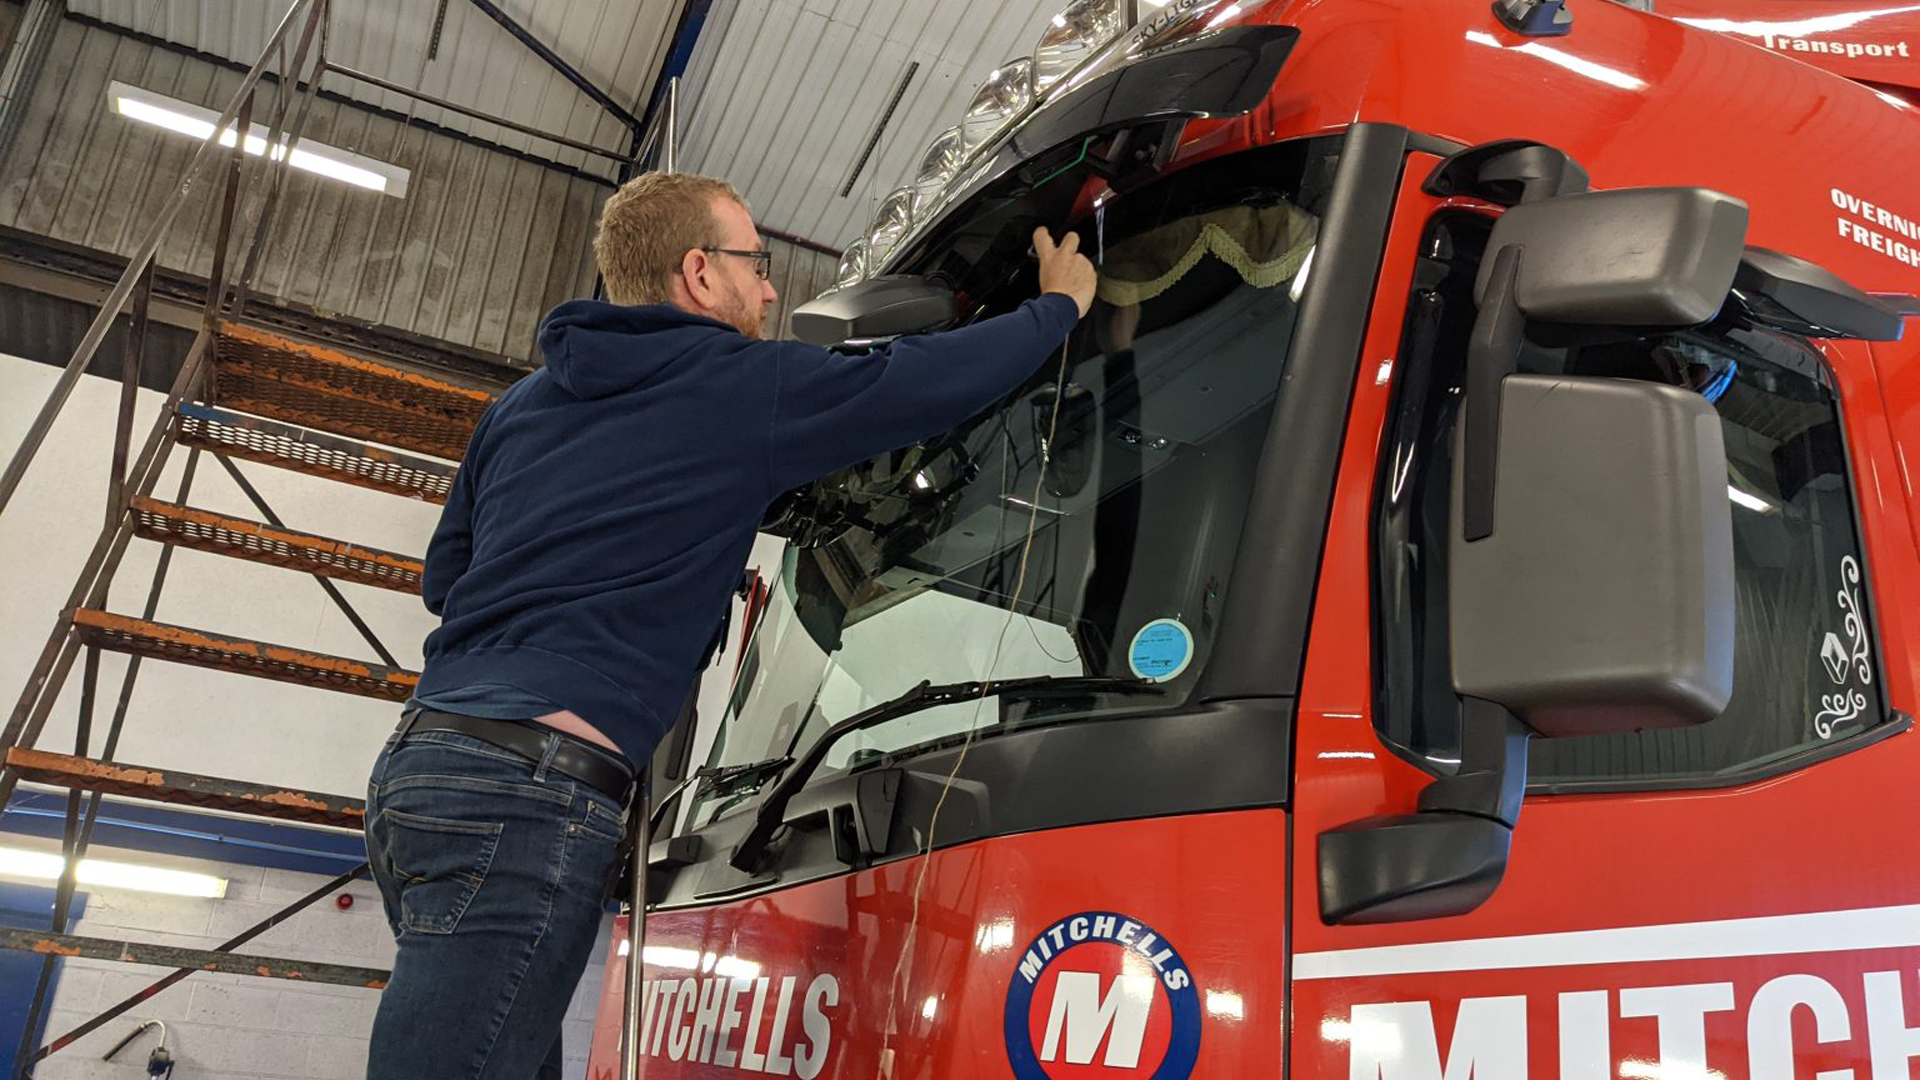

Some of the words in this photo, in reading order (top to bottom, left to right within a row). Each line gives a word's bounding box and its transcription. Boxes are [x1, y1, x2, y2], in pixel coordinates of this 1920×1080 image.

[1132, 0, 1198, 43] SKY-LIG
[1764, 34, 1910, 58] Transport
[1831, 188, 1920, 241] OVERNI
[1019, 915, 1190, 991] MITCHELLS
[617, 973, 839, 1080] ITCHELLS
[1039, 970, 1157, 1069] M
